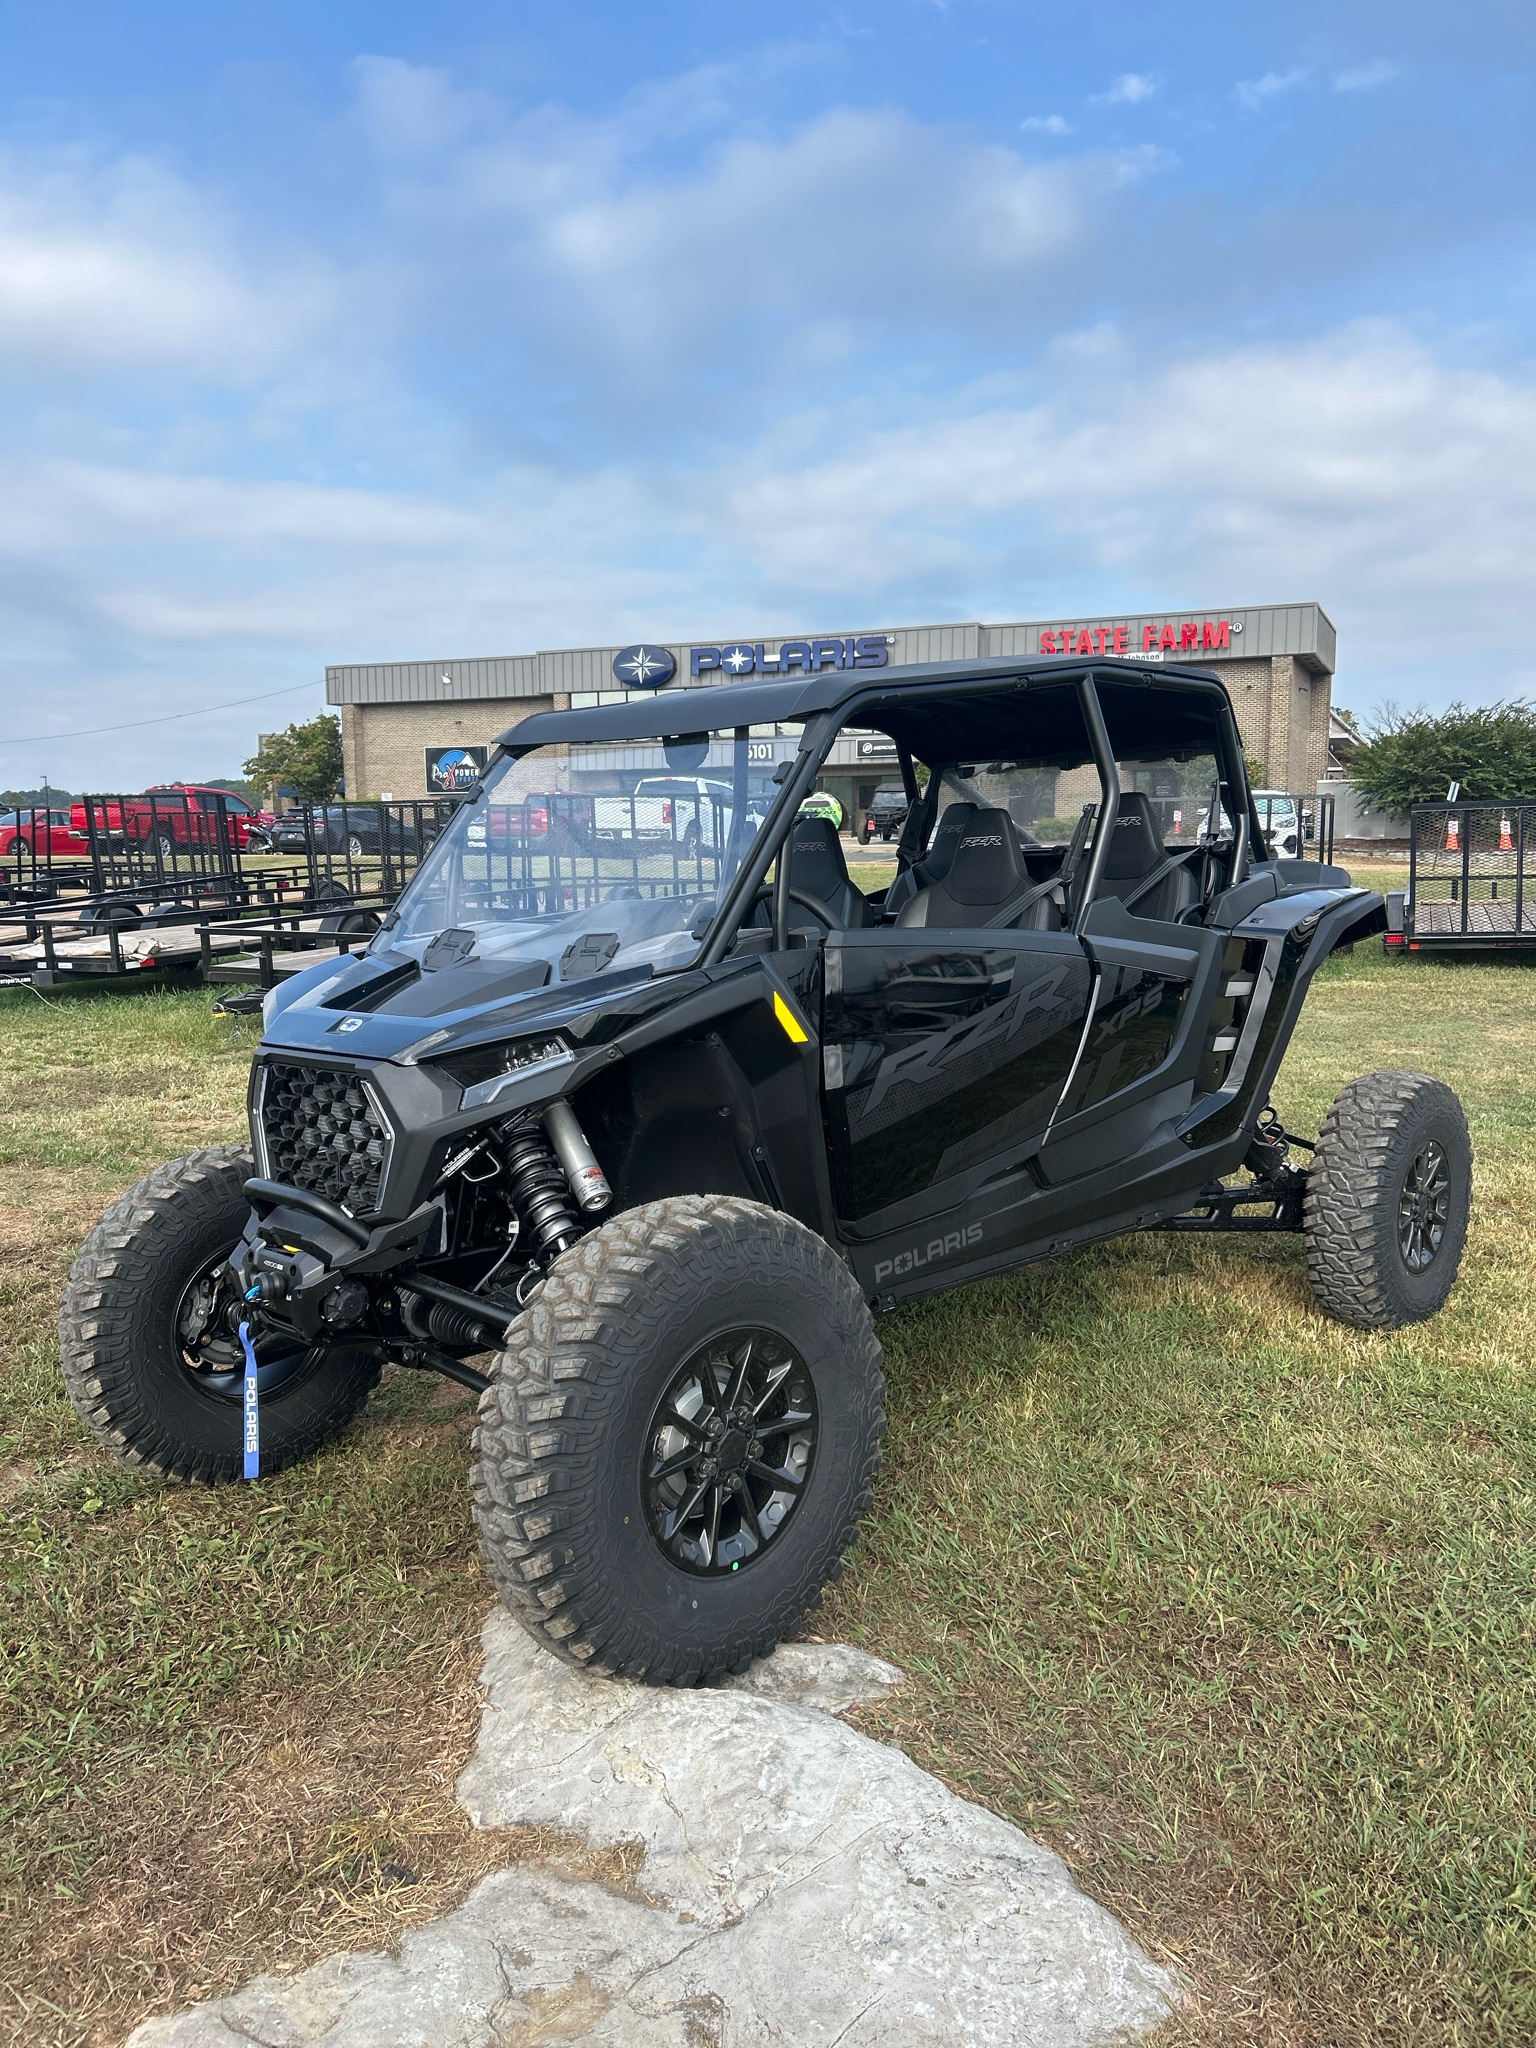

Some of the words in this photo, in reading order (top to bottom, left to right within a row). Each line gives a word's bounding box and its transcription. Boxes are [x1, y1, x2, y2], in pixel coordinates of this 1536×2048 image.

[691, 636, 889, 677] POLARIS
[1040, 626, 1130, 655] STATE
[1143, 621, 1230, 652] FARM
[455, 768, 480, 777] POWER
[793, 842, 826, 853] RZR
[960, 836, 1002, 849] RZR
[858, 964, 1072, 1122] RZR
[874, 1221, 984, 1284] POLARIS
[246, 1376, 257, 1454] POLARIS
